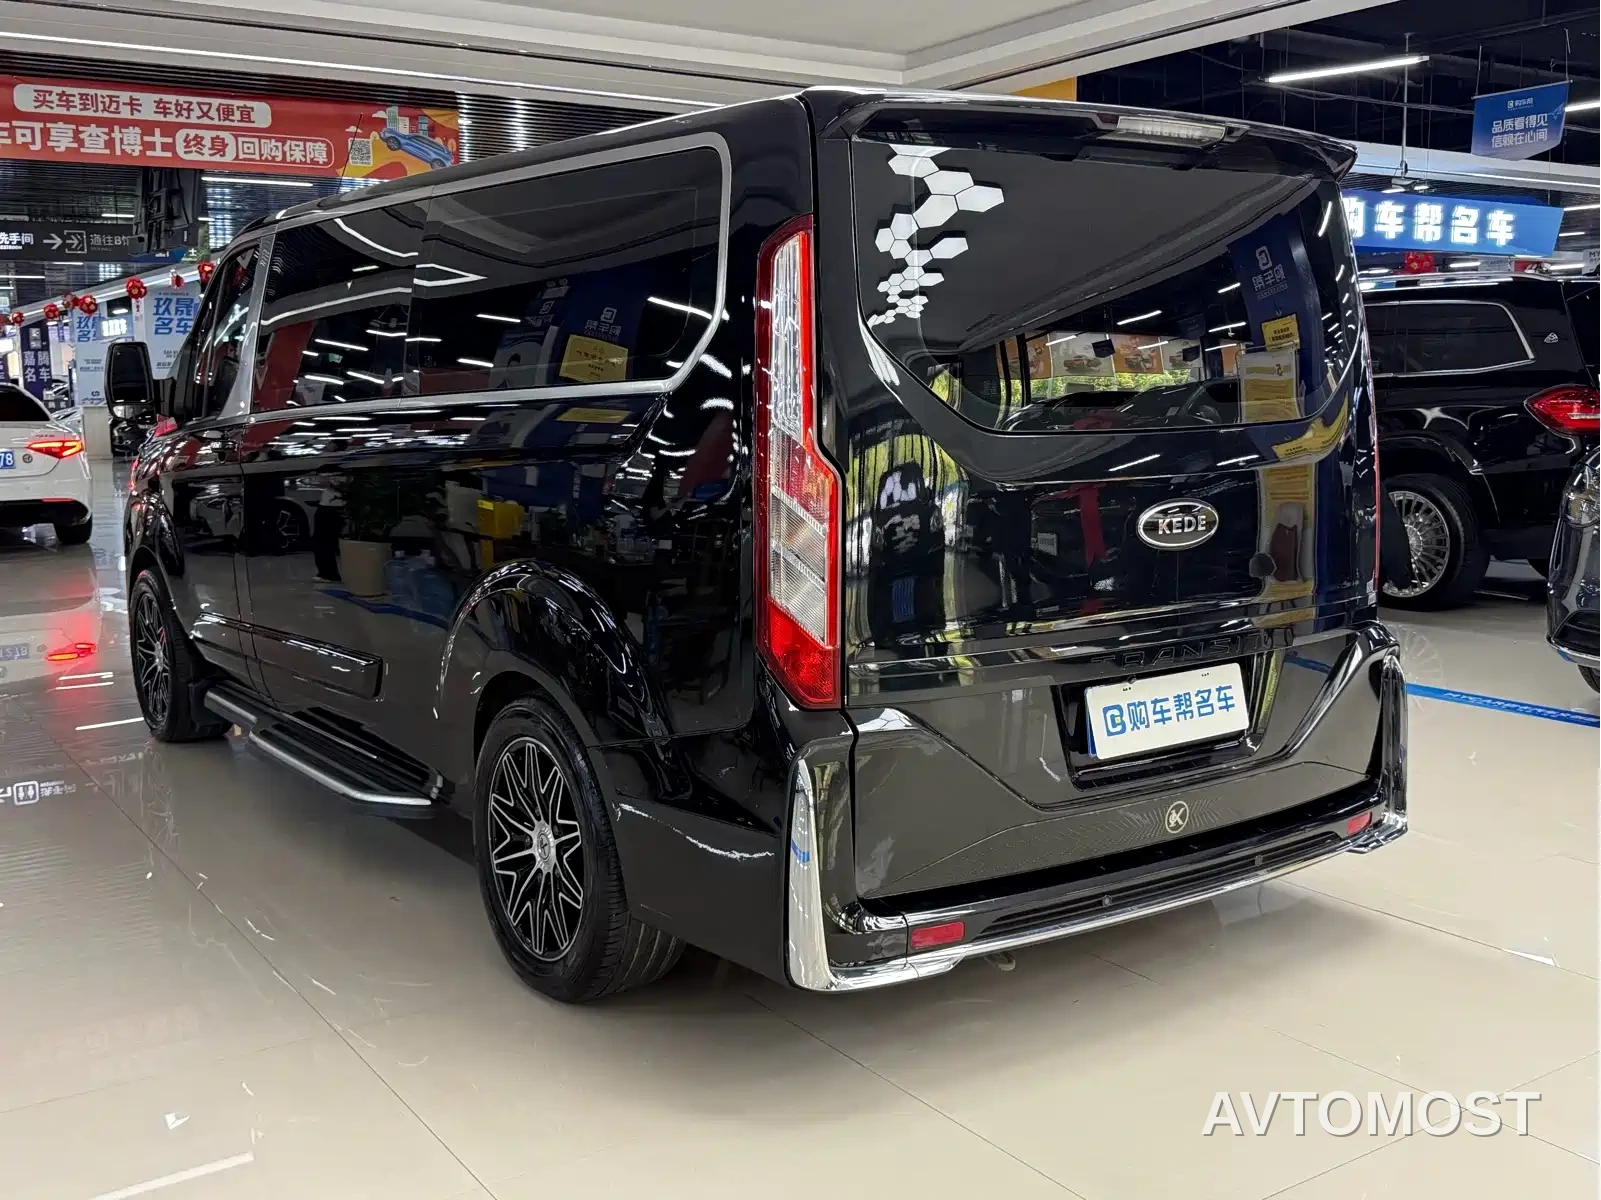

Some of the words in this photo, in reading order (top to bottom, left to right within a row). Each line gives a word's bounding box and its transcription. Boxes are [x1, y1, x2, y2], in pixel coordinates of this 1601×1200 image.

[33, 89, 143, 116] 买车到迈卡
[153, 98, 256, 124] 车好又便宜
[1491, 113, 1548, 134] 品质看得见
[1491, 128, 1548, 148] 信赖在心间
[154, 317, 194, 336] 名车
[1158, 515, 1207, 535] KEDE
[1127, 685, 1236, 731] 购车帮名车
